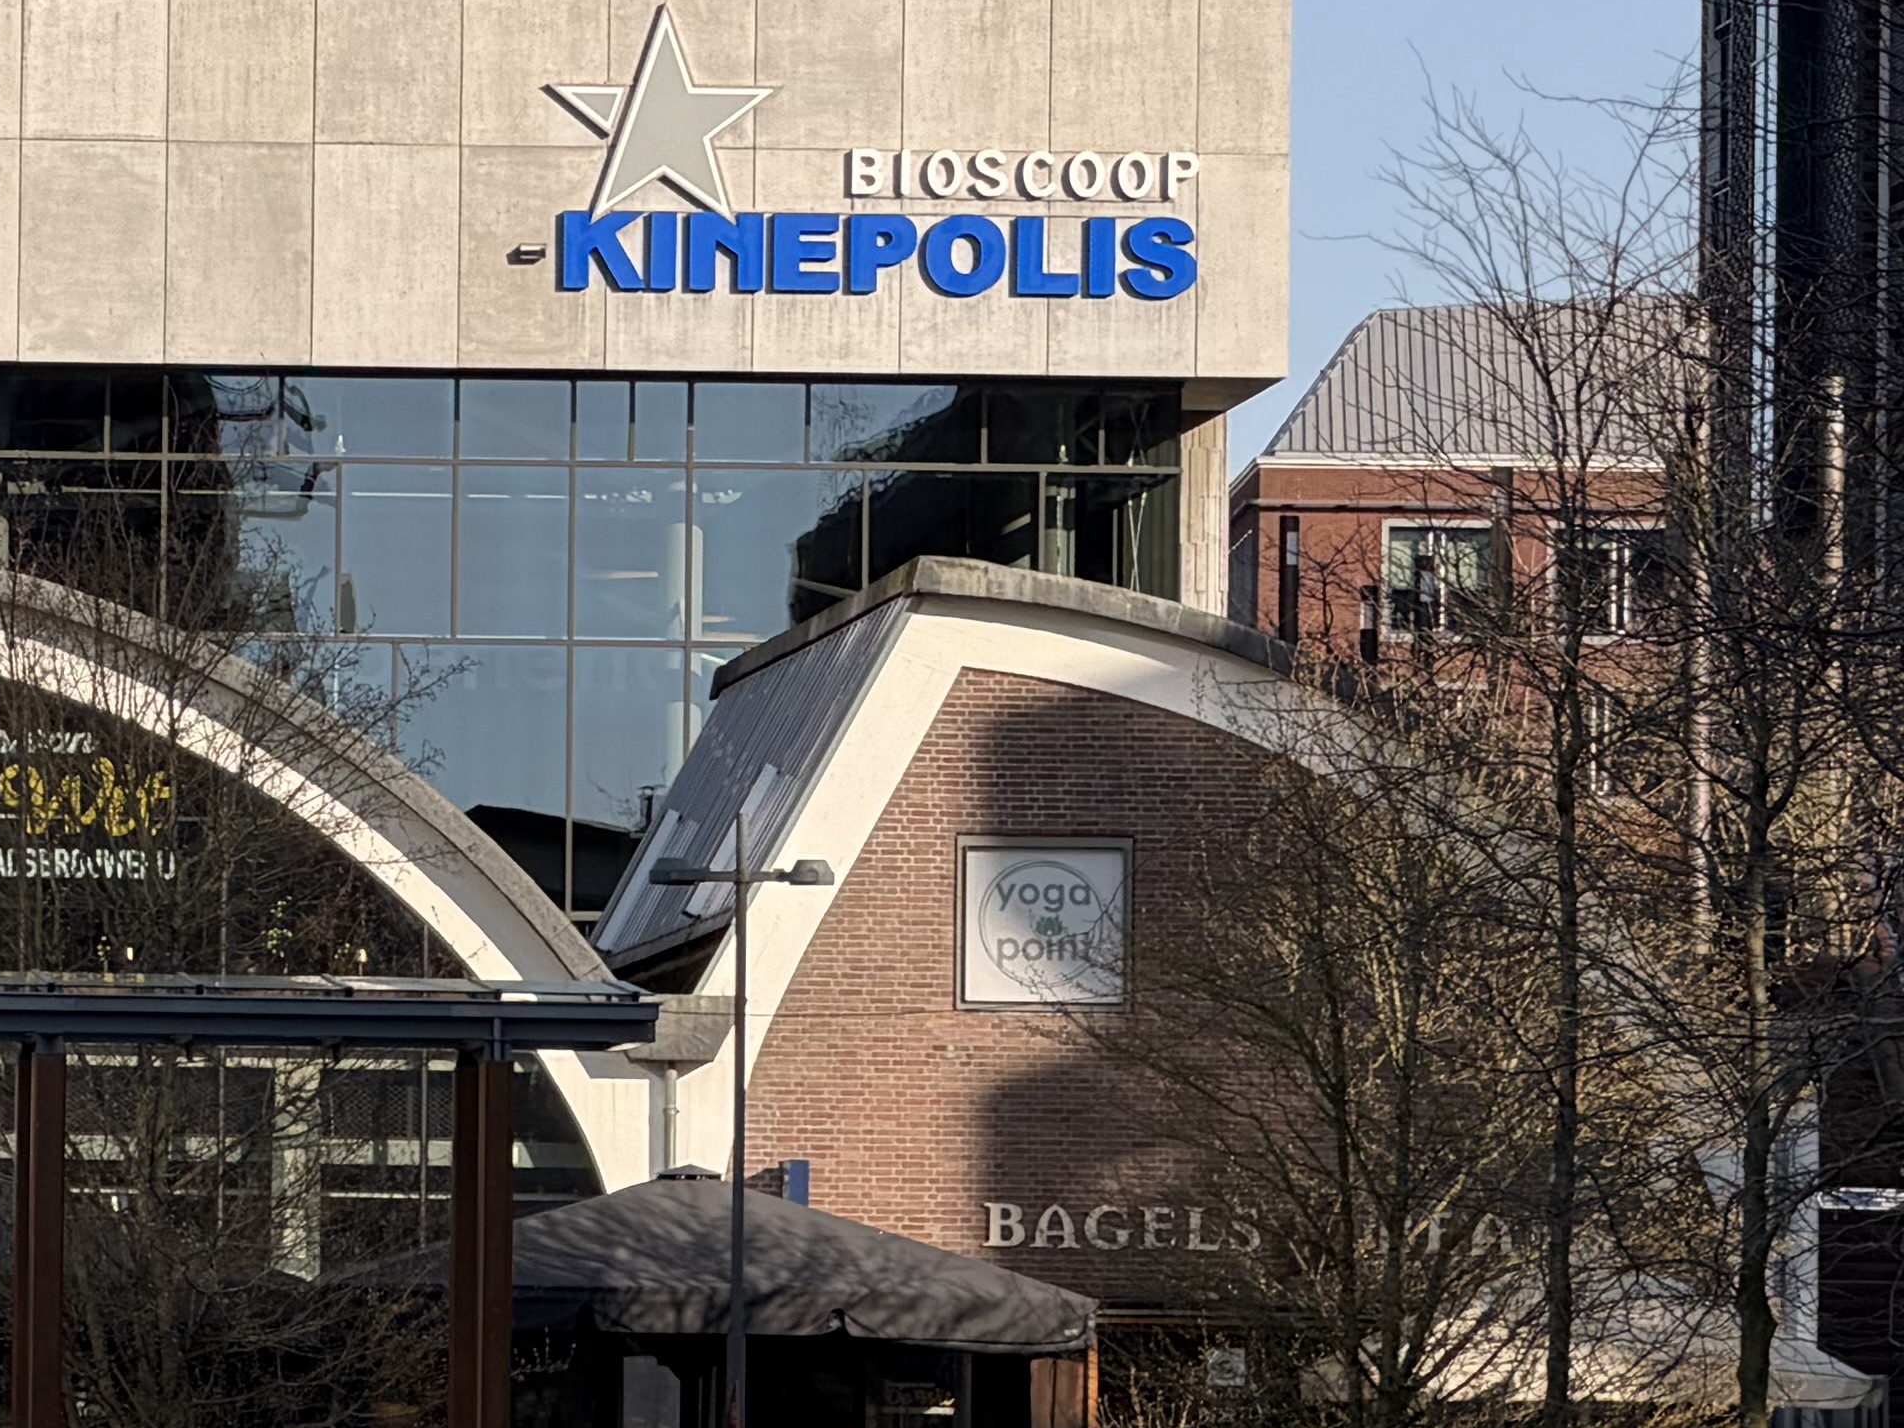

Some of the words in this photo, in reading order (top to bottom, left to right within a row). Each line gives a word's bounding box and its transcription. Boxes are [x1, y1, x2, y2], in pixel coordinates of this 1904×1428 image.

[849, 147, 1200, 202] BIOSCOOP
[558, 210, 1199, 300] KINEPOLIS
[995, 876, 1091, 913] yoga
[996, 930, 1090, 967] point
[982, 1201, 1262, 1254] BAGELS
